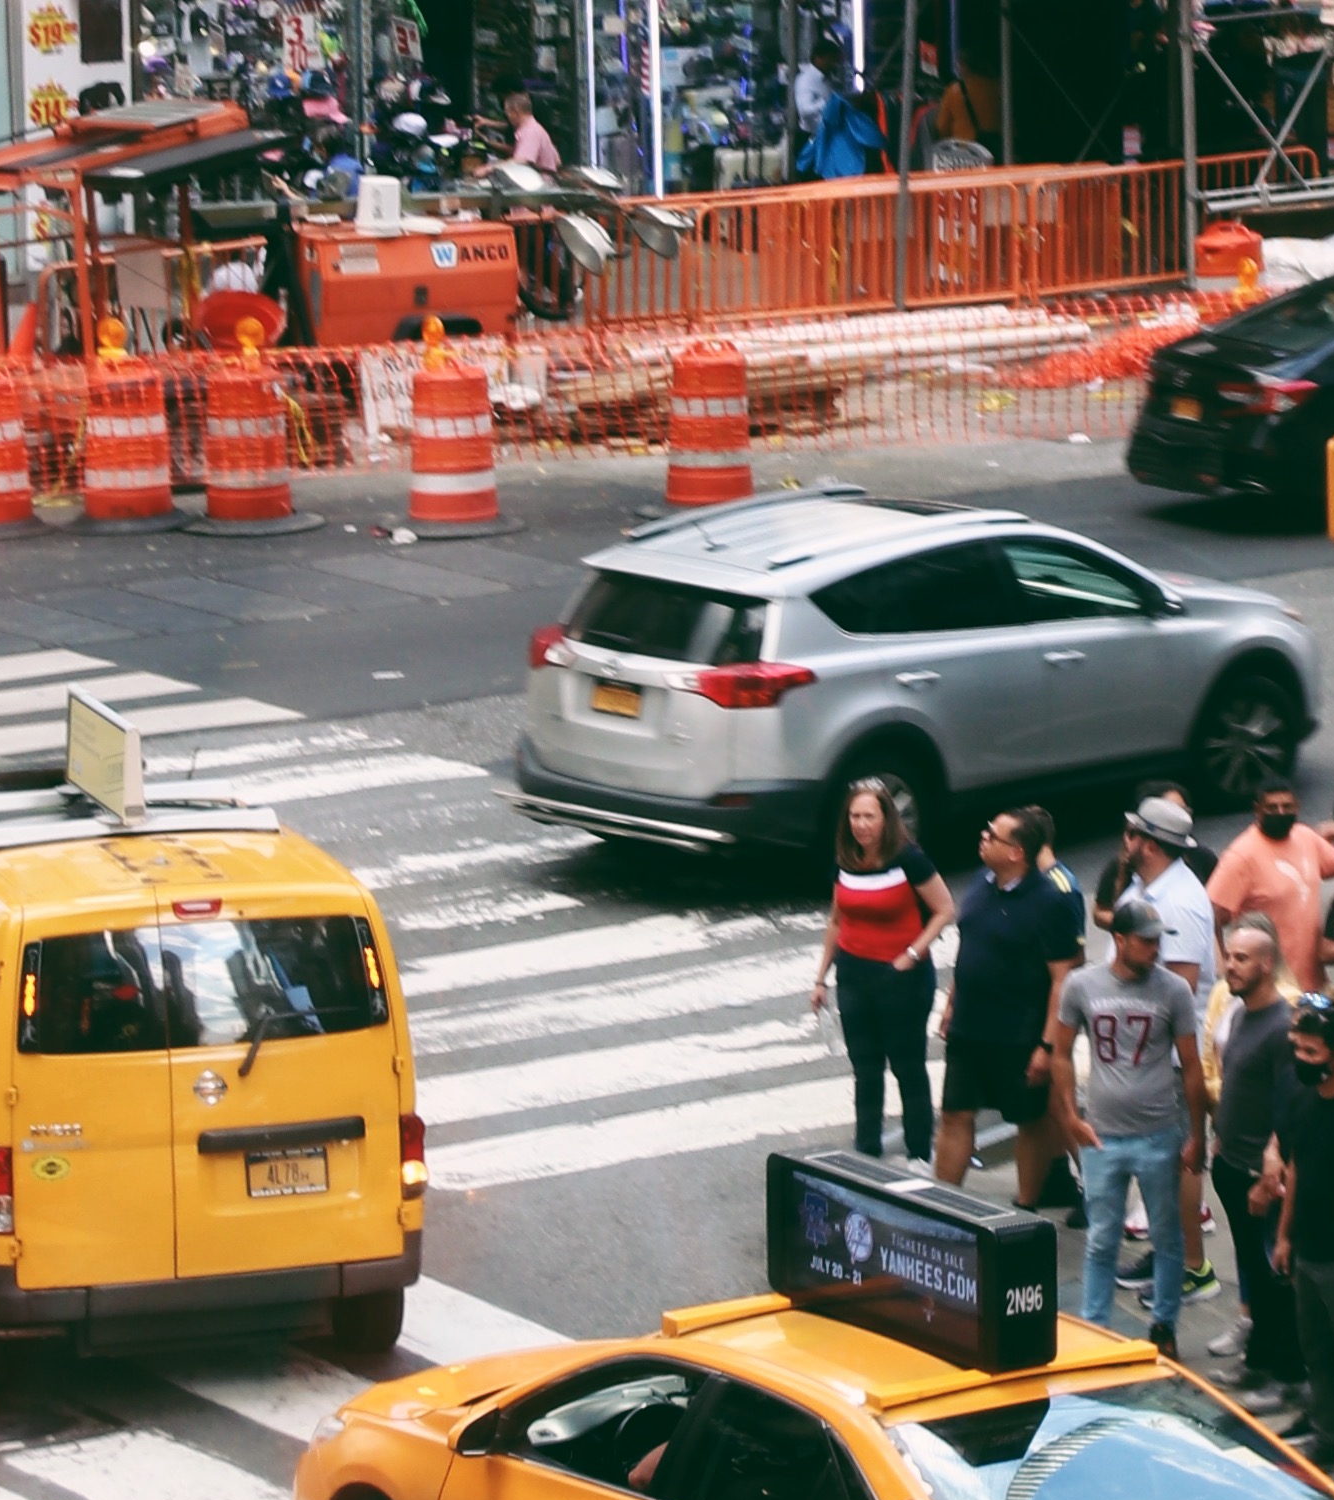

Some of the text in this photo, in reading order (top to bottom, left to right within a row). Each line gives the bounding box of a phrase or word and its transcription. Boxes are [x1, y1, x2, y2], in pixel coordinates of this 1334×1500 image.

[433, 243, 510, 264] WANCO
[1093, 1013, 1153, 1067] 87
[891, 1232, 965, 1271] TICKETS ON SALE
[810, 1255, 862, 1287] JULY 20 21
[879, 1247, 978, 1305] YANKEES.COM
[1006, 1283, 1044, 1317] 2N96
